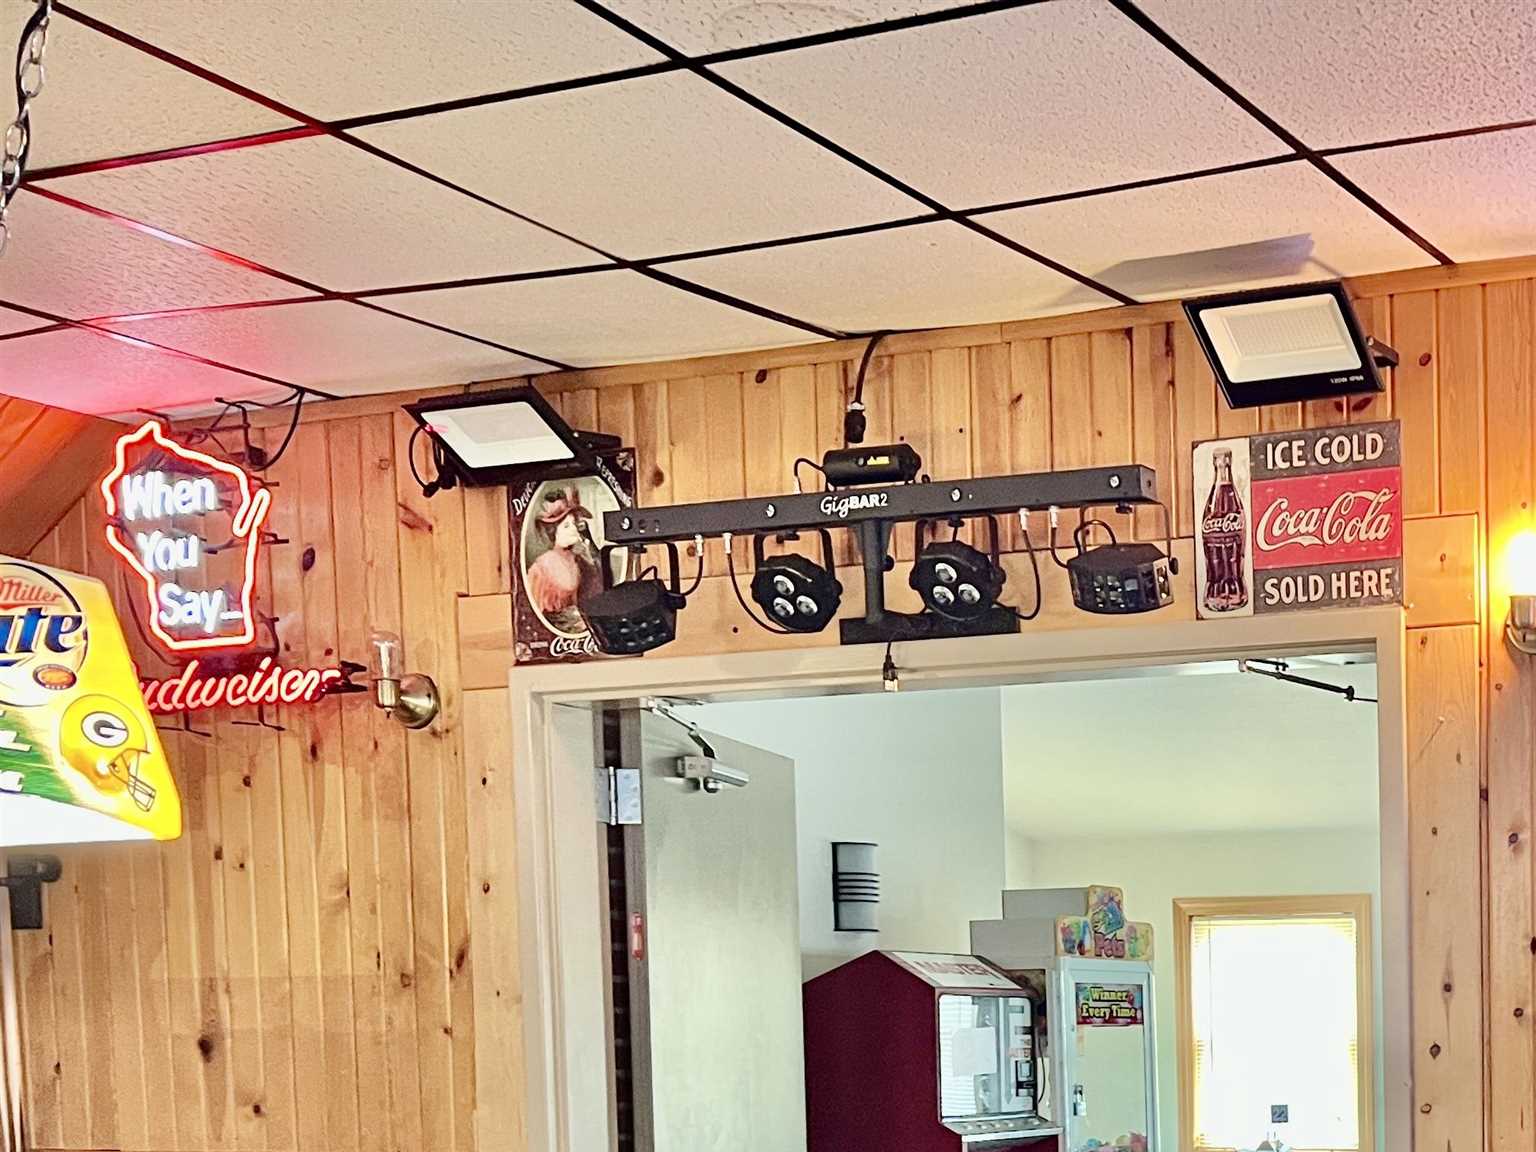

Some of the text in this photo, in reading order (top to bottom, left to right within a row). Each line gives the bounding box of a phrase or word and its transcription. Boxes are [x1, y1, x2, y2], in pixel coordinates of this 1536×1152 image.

[1266, 432, 1385, 470] ICE COLD
[121, 470, 217, 521] When
[1256, 487, 1397, 552] Coca-Cola
[136, 529, 200, 572] You
[1264, 567, 1394, 605] SOLD HERE
[0, 607, 83, 654] ite
[139, 656, 342, 711] udweiser
[1081, 1002, 1137, 1019] Every Time
[1090, 986, 1129, 1002] Winner
